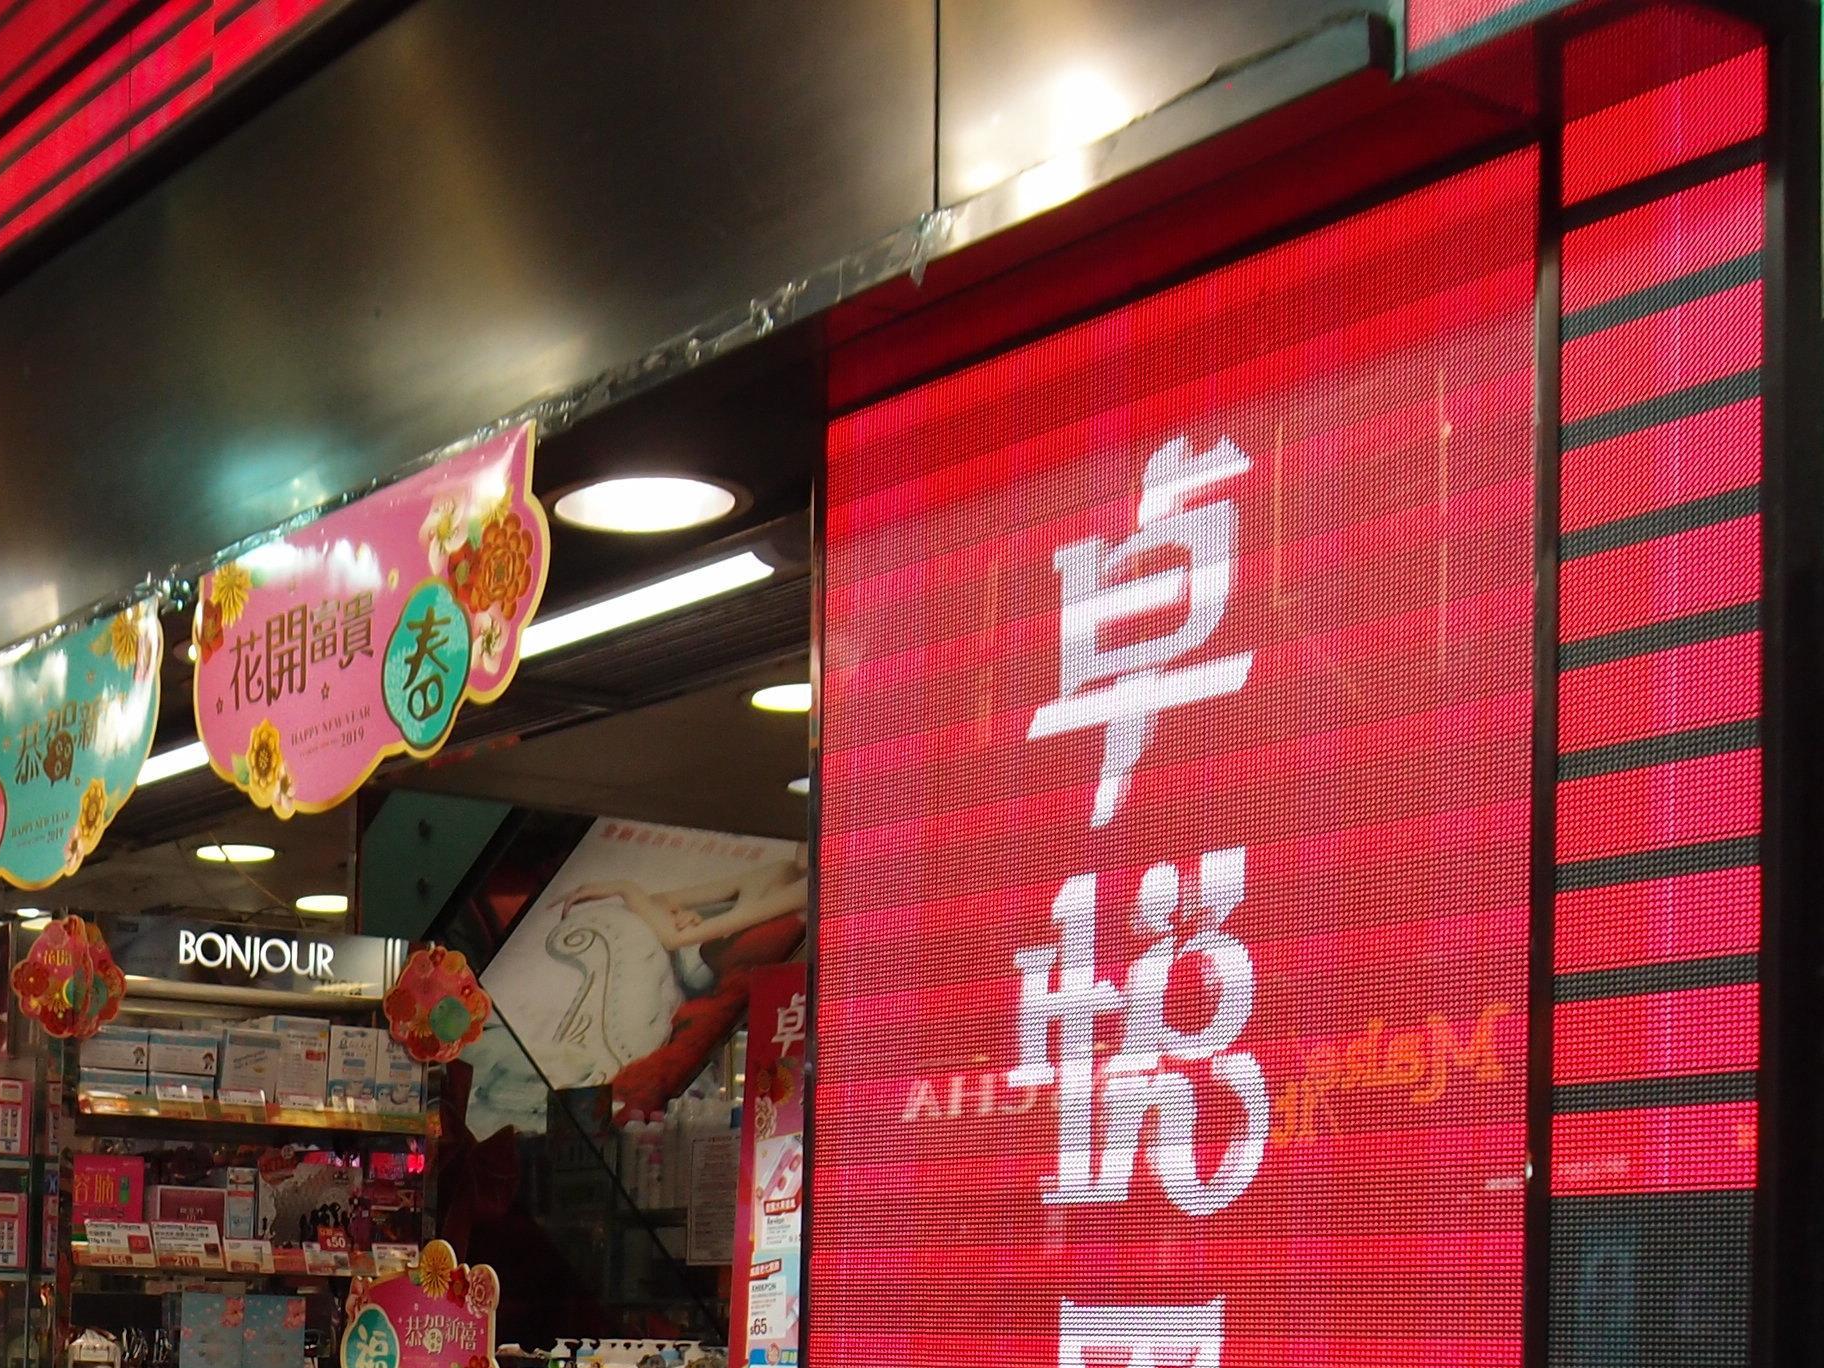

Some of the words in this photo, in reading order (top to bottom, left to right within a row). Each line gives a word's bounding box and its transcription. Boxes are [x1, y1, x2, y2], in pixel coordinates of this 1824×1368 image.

[229, 590, 375, 712] 花開富貴
[403, 606, 450, 722] 春
[341, 726, 365, 747] 2019
[1006, 433, 1268, 1217] 卓悅
[178, 929, 335, 979] BONJOUR
[404, 1313, 477, 1354] 恭賀新禧
